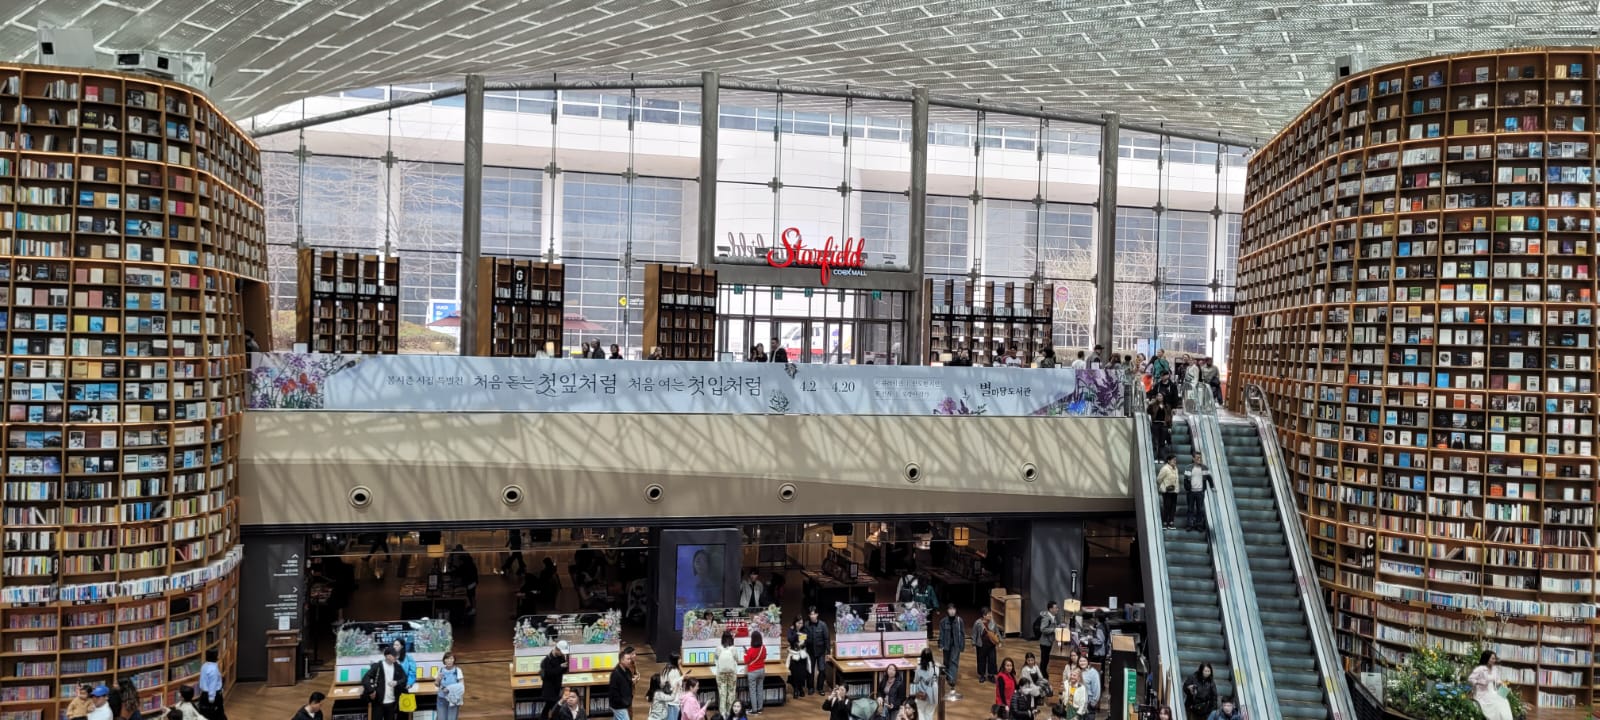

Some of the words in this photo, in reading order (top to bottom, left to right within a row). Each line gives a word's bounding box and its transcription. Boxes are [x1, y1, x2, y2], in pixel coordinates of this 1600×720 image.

[767, 227, 866, 286] Starfield
[516, 270, 523, 281] G
[833, 268, 851, 276] COEX
[474, 374, 503, 390] 처음
[505, 375, 535, 390] 돋는
[536, 372, 616, 397] 첫잎처럼
[628, 376, 655, 392] 처음
[658, 377, 685, 392] 여는
[687, 375, 761, 396] 첫입처럼
[800, 380, 816, 391] 4.2
[831, 381, 855, 392] 4.20
[980, 381, 1032, 397] 별마당도서관
[1367, 535, 1374, 548] C
